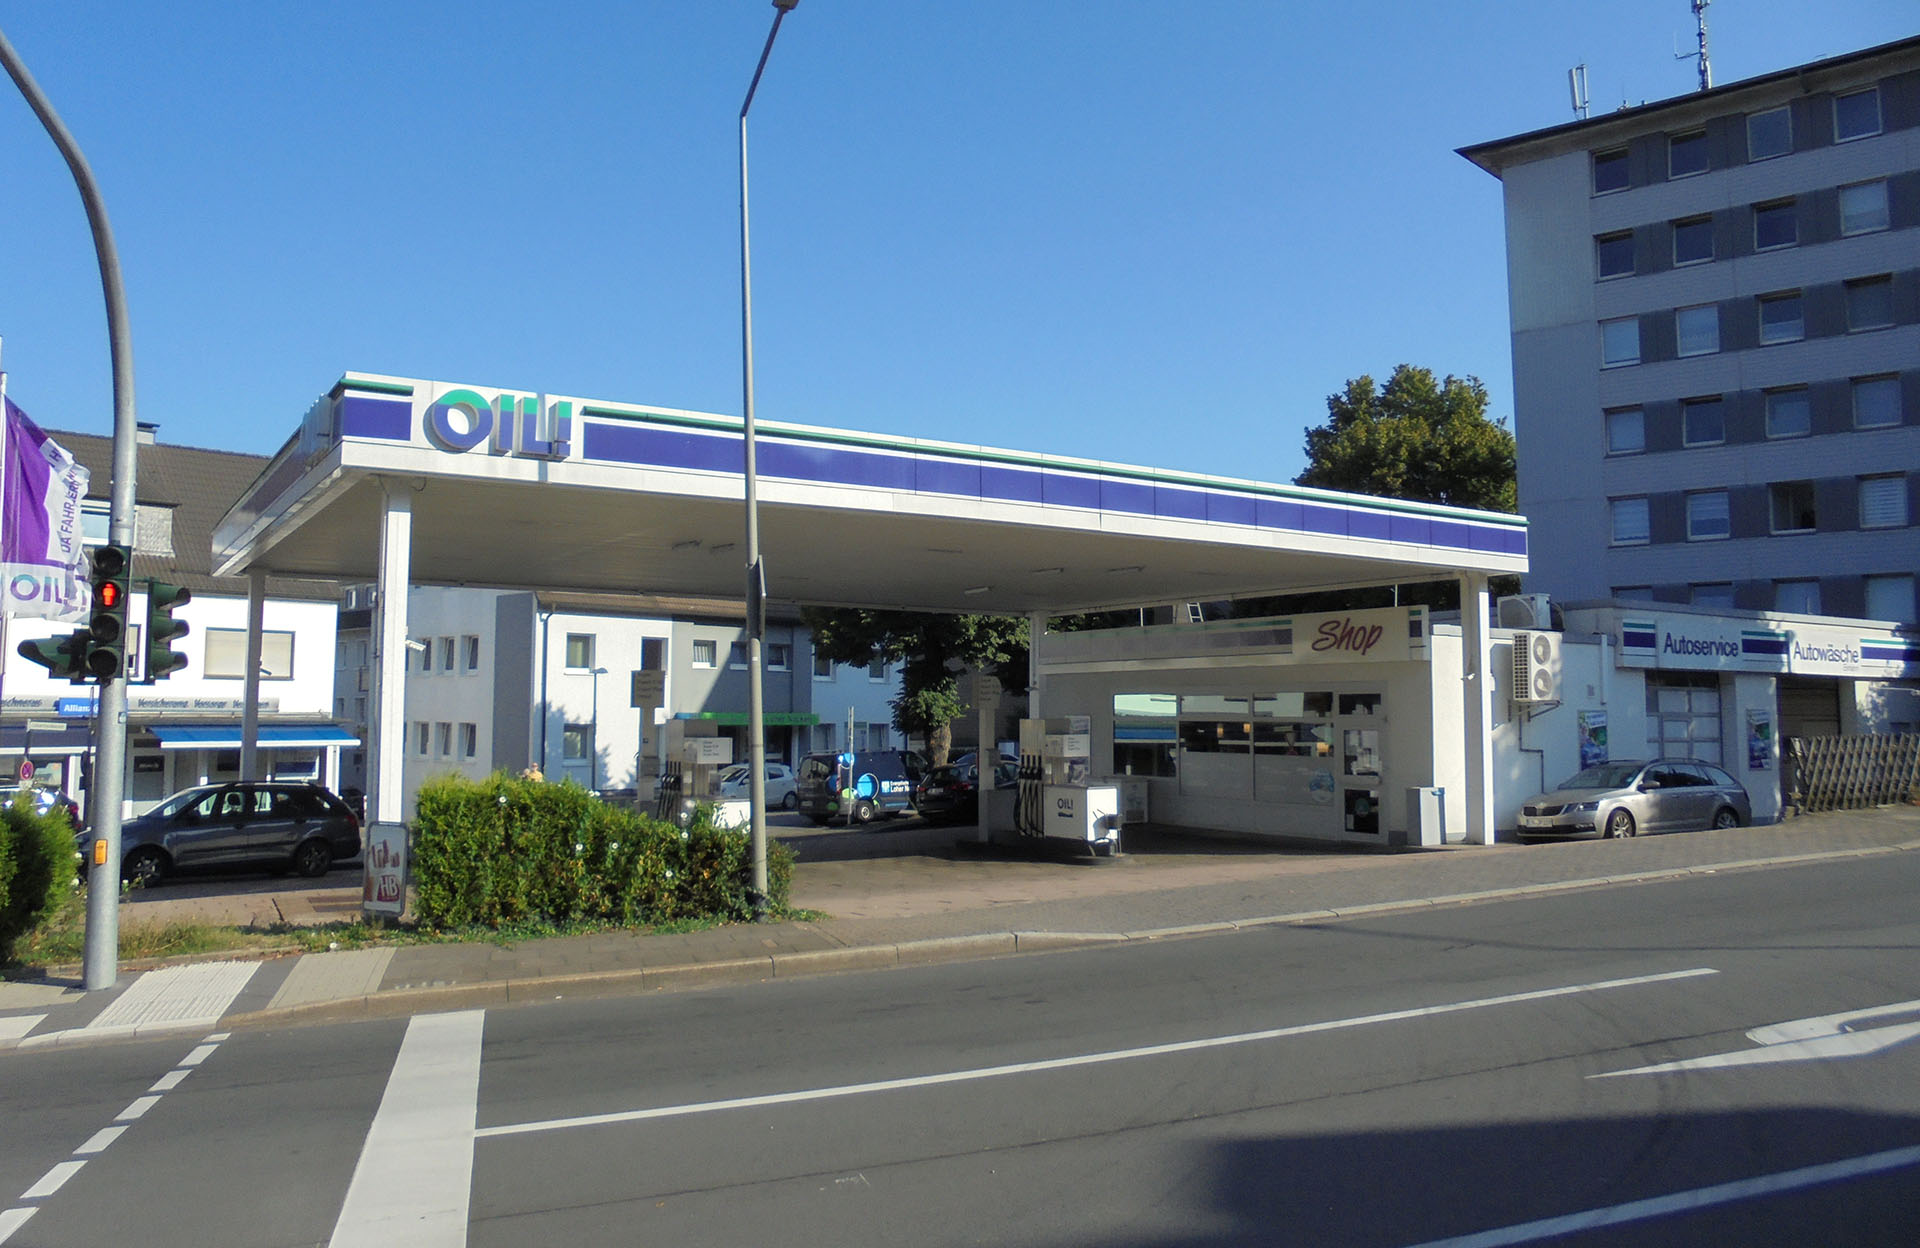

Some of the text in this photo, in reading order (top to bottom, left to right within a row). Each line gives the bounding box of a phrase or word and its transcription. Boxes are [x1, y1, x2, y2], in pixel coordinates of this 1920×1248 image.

[426, 389, 572, 461] OIL!
[1311, 617, 1383, 656] Shop
[1663, 632, 1739, 657] Autoservice
[1793, 641, 1859, 664] Autowäsche
[381, 875, 398, 897] HB
